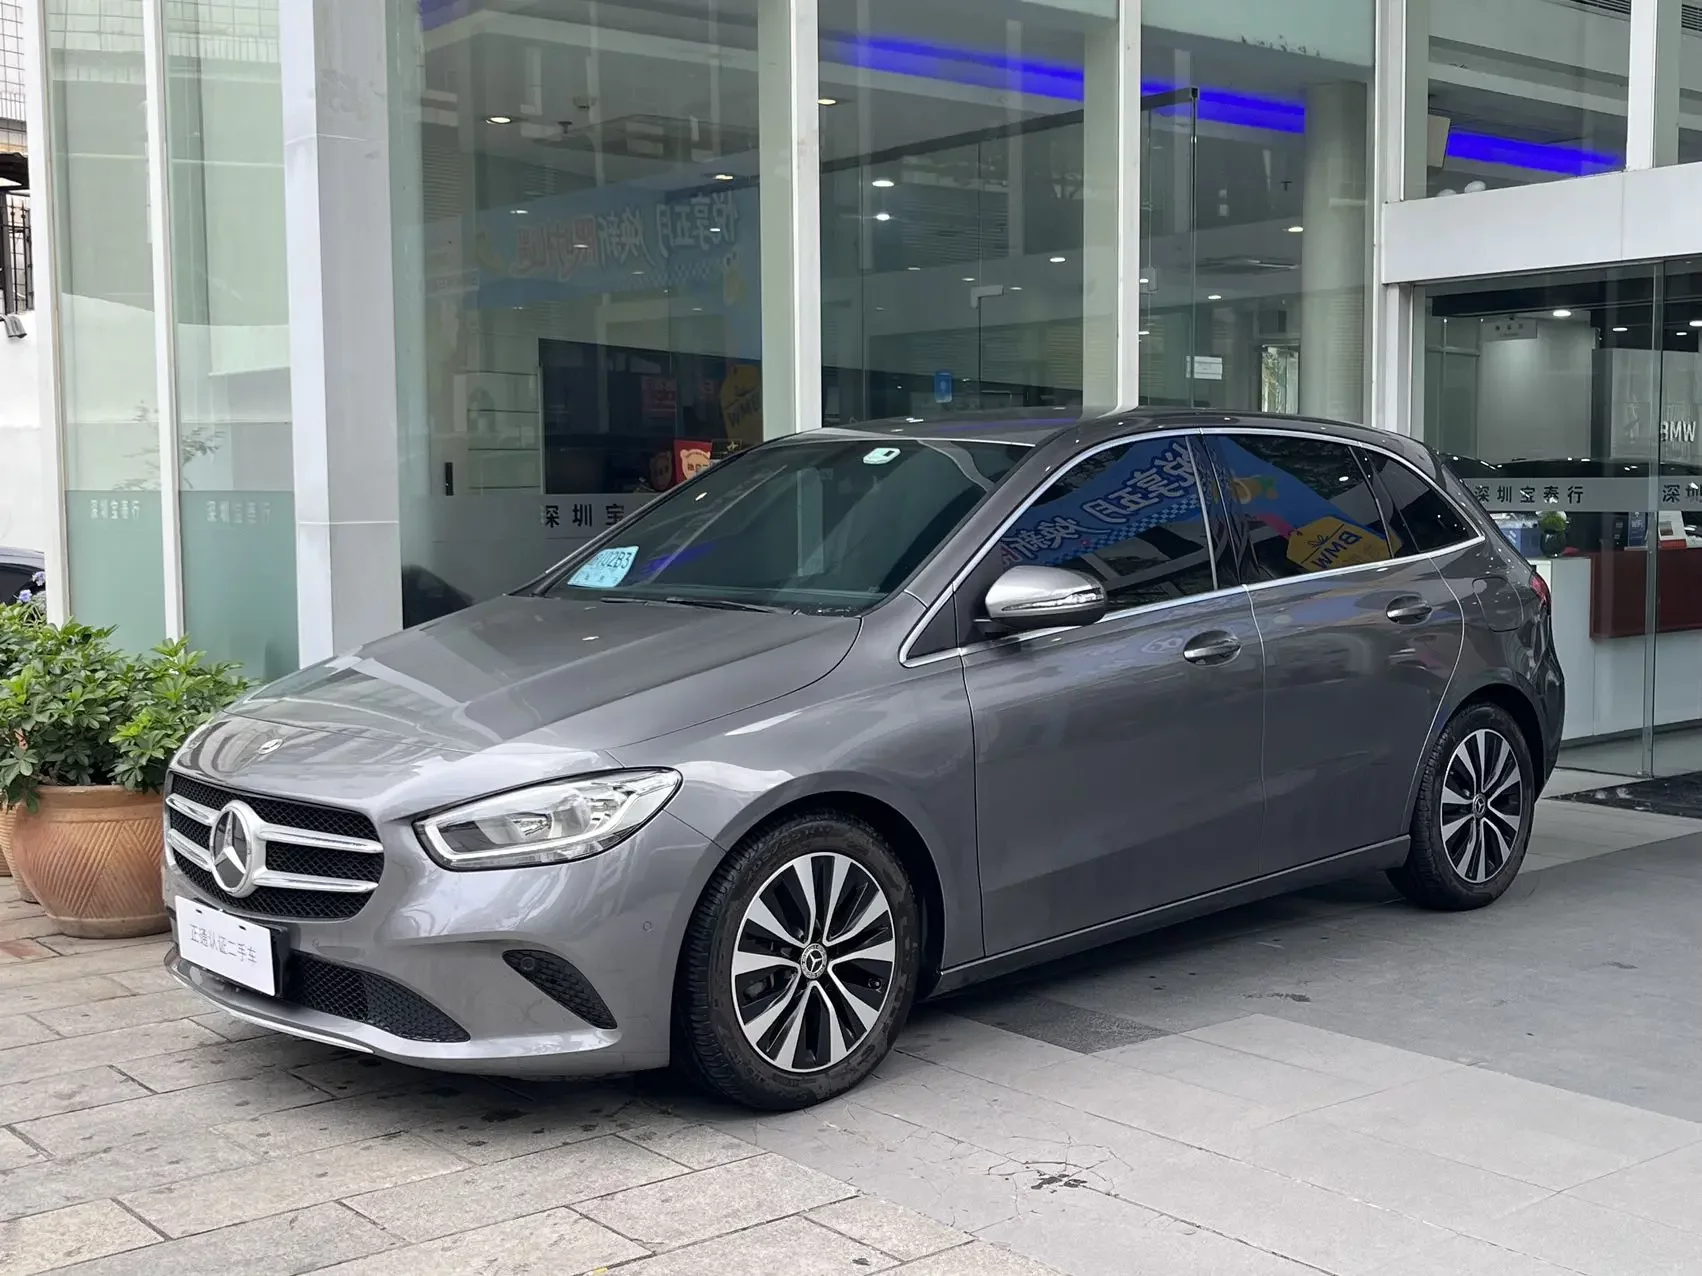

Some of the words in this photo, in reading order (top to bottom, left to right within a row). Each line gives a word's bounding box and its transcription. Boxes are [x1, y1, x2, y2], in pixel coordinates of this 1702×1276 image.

[1660, 420, 1697, 443] BMW
[1474, 485, 1584, 504] 深圳宝泰行
